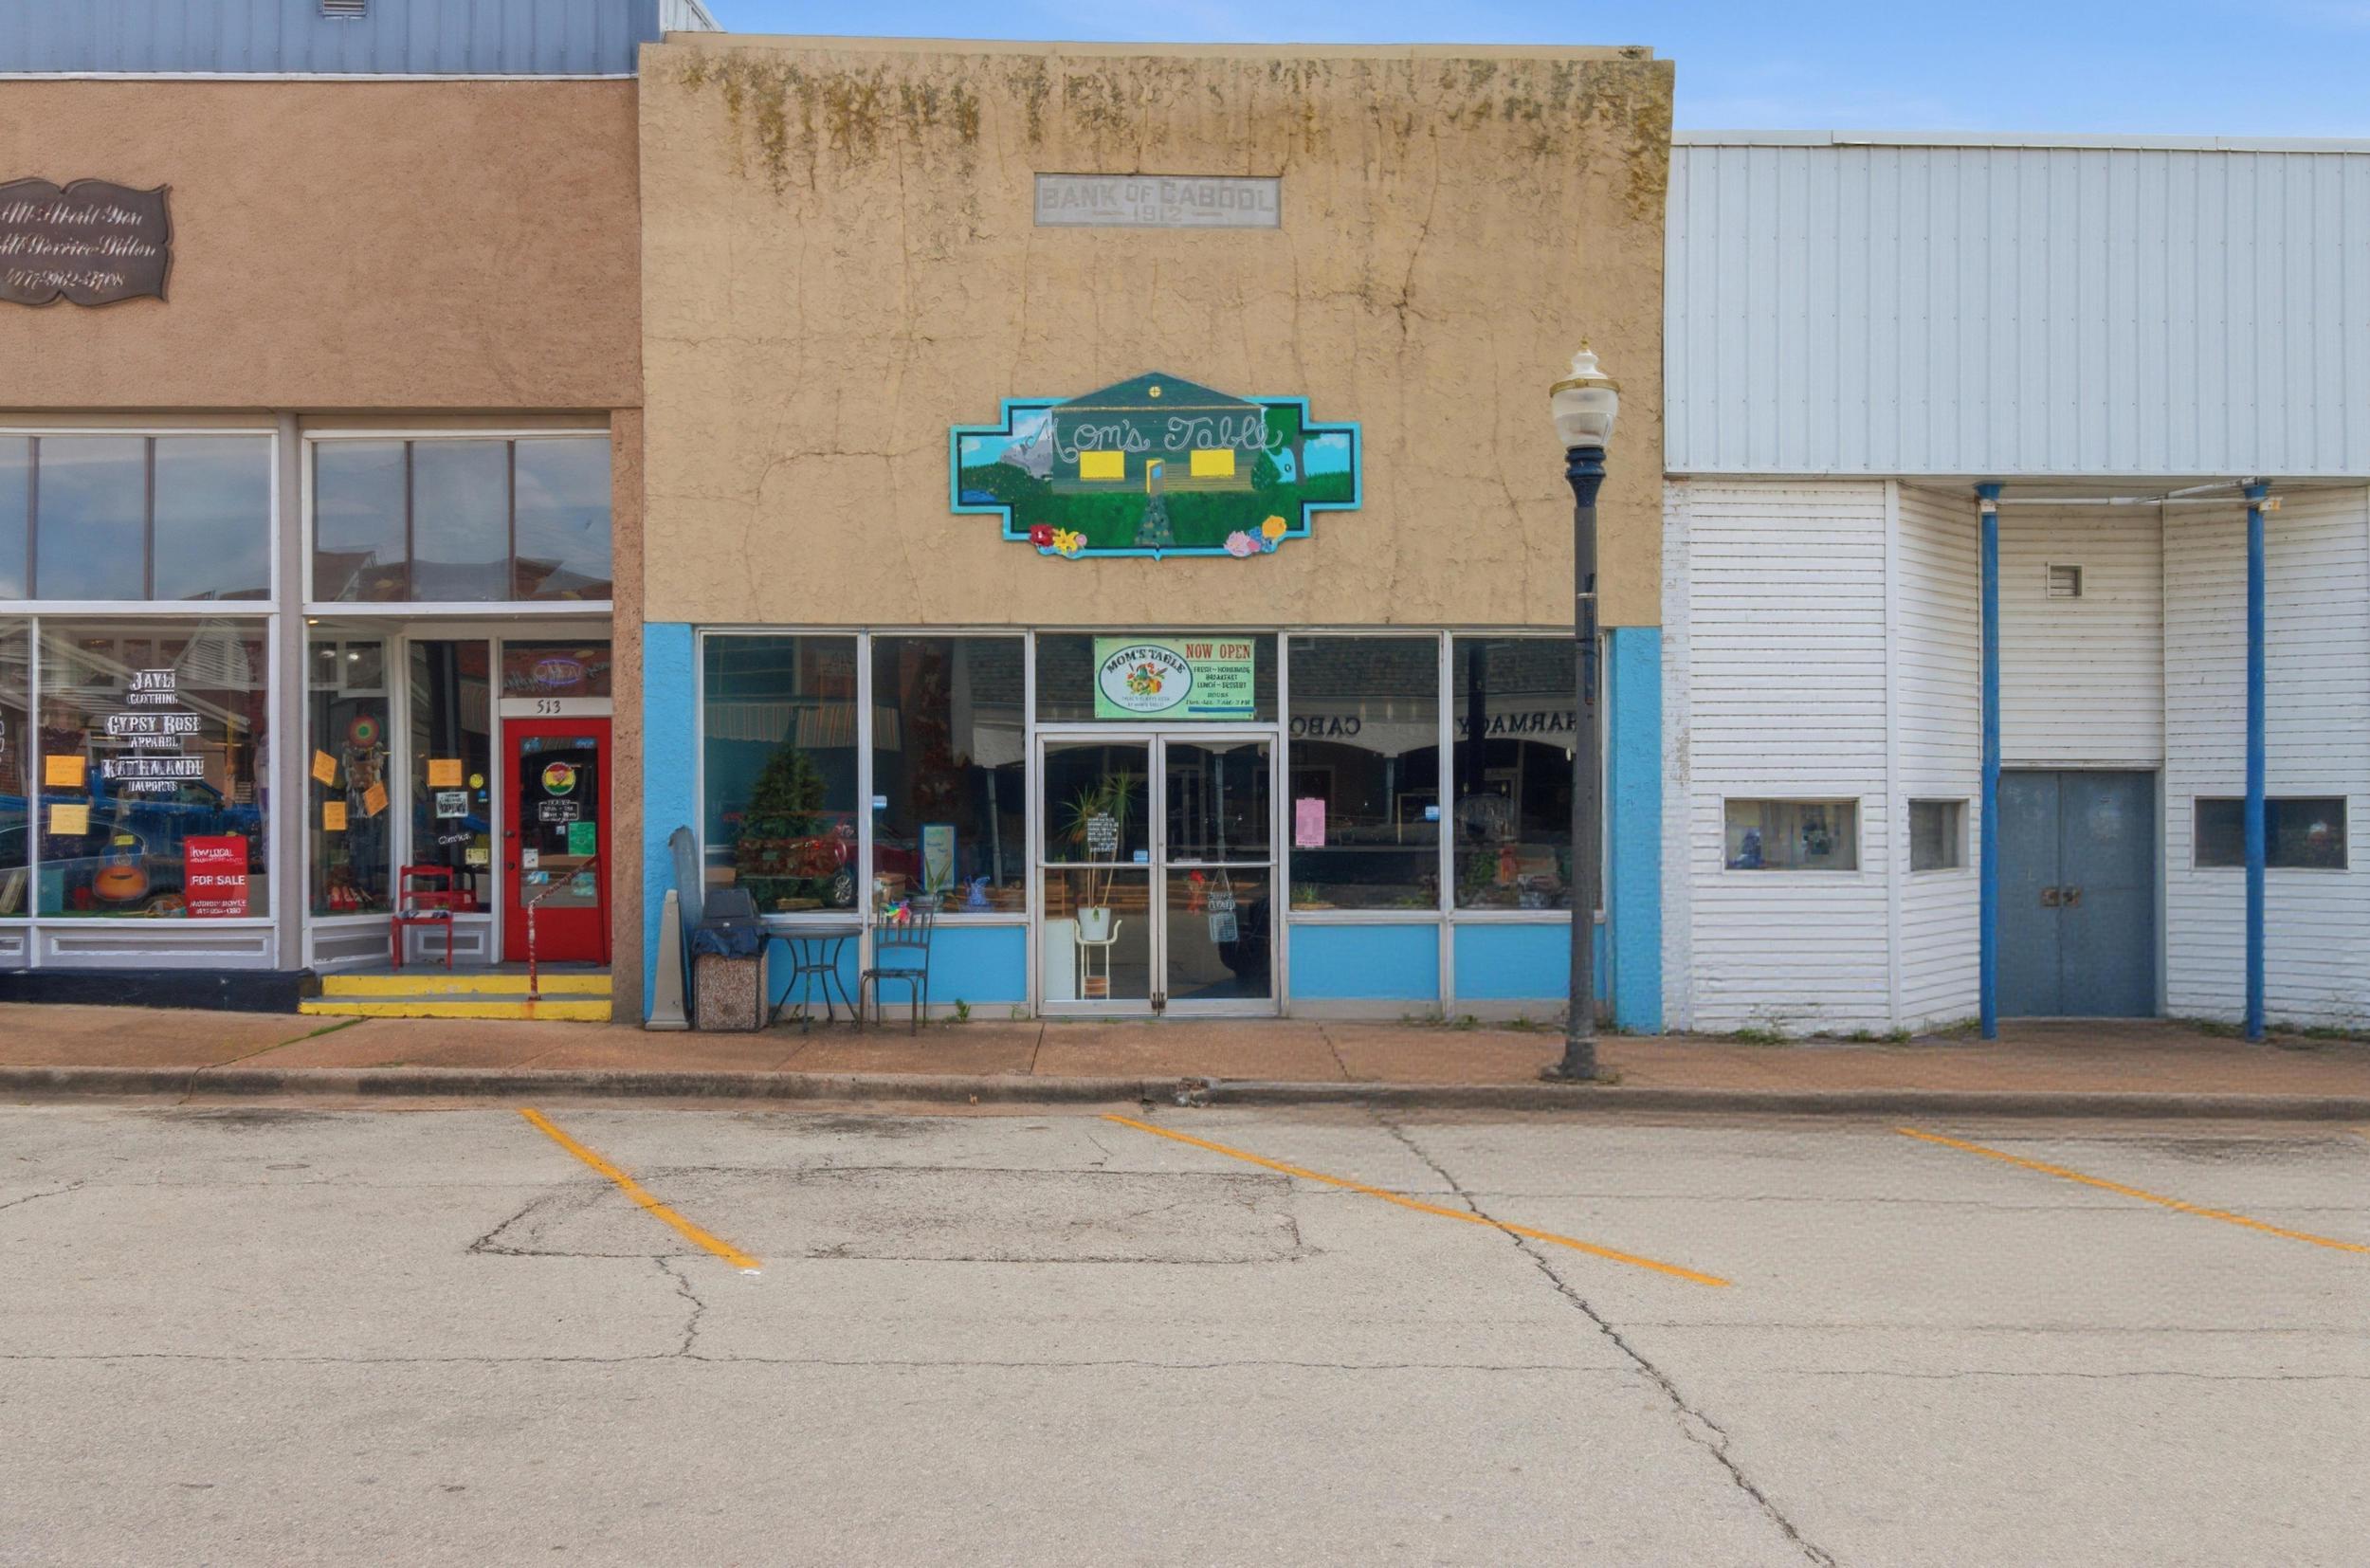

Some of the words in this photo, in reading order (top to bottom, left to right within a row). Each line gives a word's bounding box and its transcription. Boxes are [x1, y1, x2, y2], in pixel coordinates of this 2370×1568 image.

[1043, 184, 1117, 210] BANK
[1124, 183, 1153, 203] OF
[1159, 181, 1274, 212] CABOOL
[1133, 205, 1183, 222] 1912
[1025, 417, 1151, 463] Mom's
[1164, 415, 1283, 450] Table
[1186, 644, 1213, 659] NOW
[1220, 644, 1250, 659] OPEN
[1106, 649, 1146, 674] MOM'S
[1148, 649, 1186, 674] TABLE
[537, 700, 561, 714] 513
[106, 715, 156, 736] GYPSY
[163, 715, 202, 735] ROSE
[130, 736, 179, 747] APPAREL
[128, 781, 178, 792] IMPORTS
[191, 875, 213, 885] FOR
[217, 875, 246, 885] SALE
